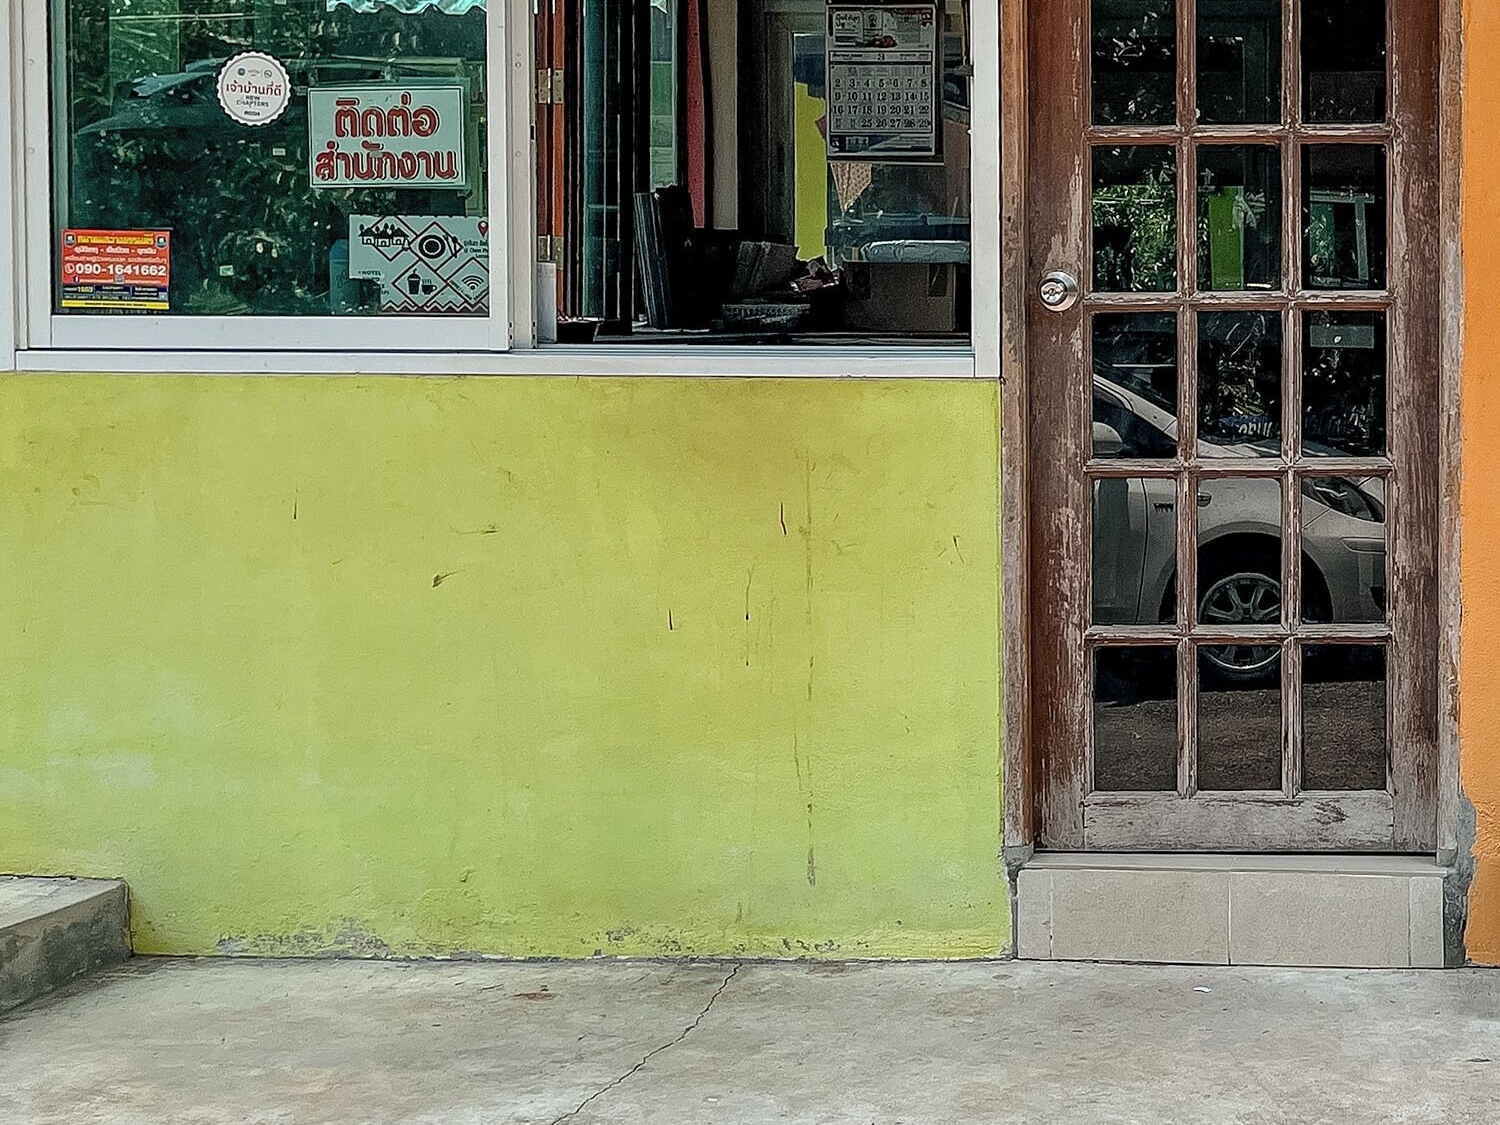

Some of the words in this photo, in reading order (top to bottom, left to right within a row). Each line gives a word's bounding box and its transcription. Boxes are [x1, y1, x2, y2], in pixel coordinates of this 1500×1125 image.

[226, 79, 282, 96] เจ้าบ้านที่ดี
[334, 91, 440, 138] ติดต่อ
[315, 140, 458, 181] สำนักงาน
